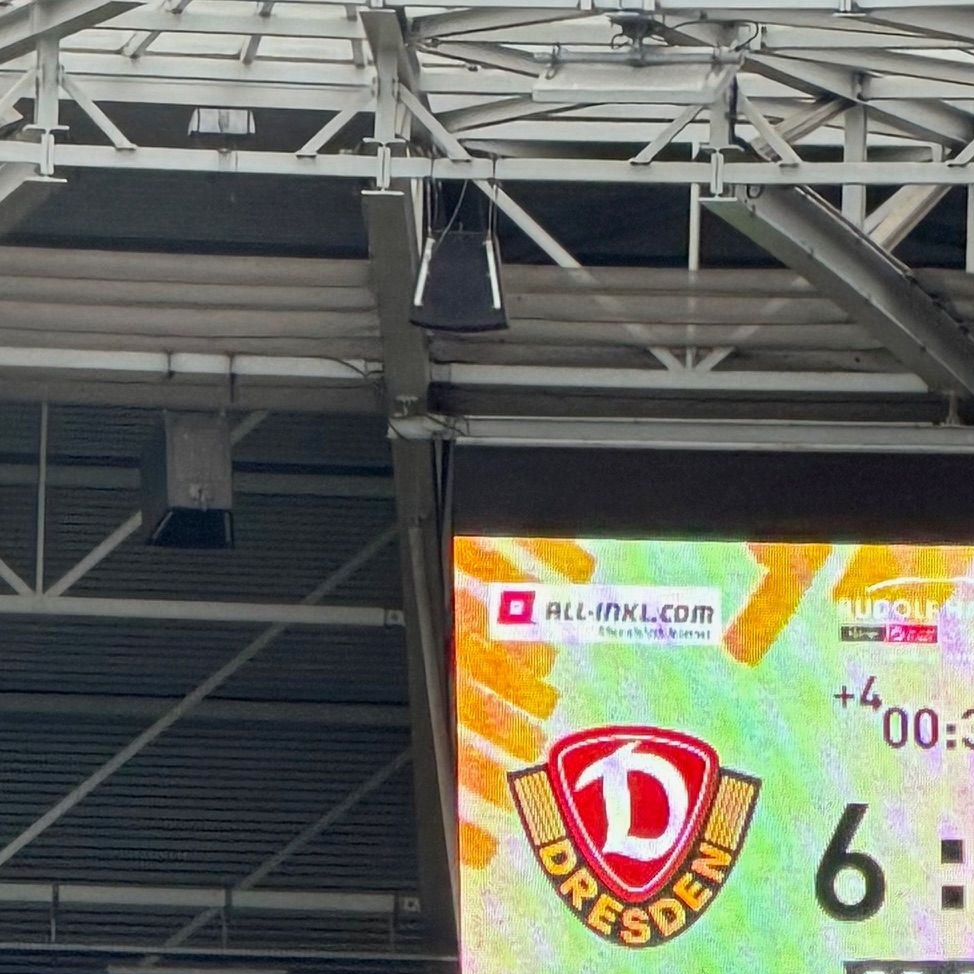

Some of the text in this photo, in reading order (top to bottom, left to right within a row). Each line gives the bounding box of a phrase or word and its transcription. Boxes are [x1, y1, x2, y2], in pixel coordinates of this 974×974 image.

[834, 676, 883, 711] +4
[539, 838, 733, 945] DRESDEN
[815, 803, 885, 922] 6
[940, 839, 964, 910] :
